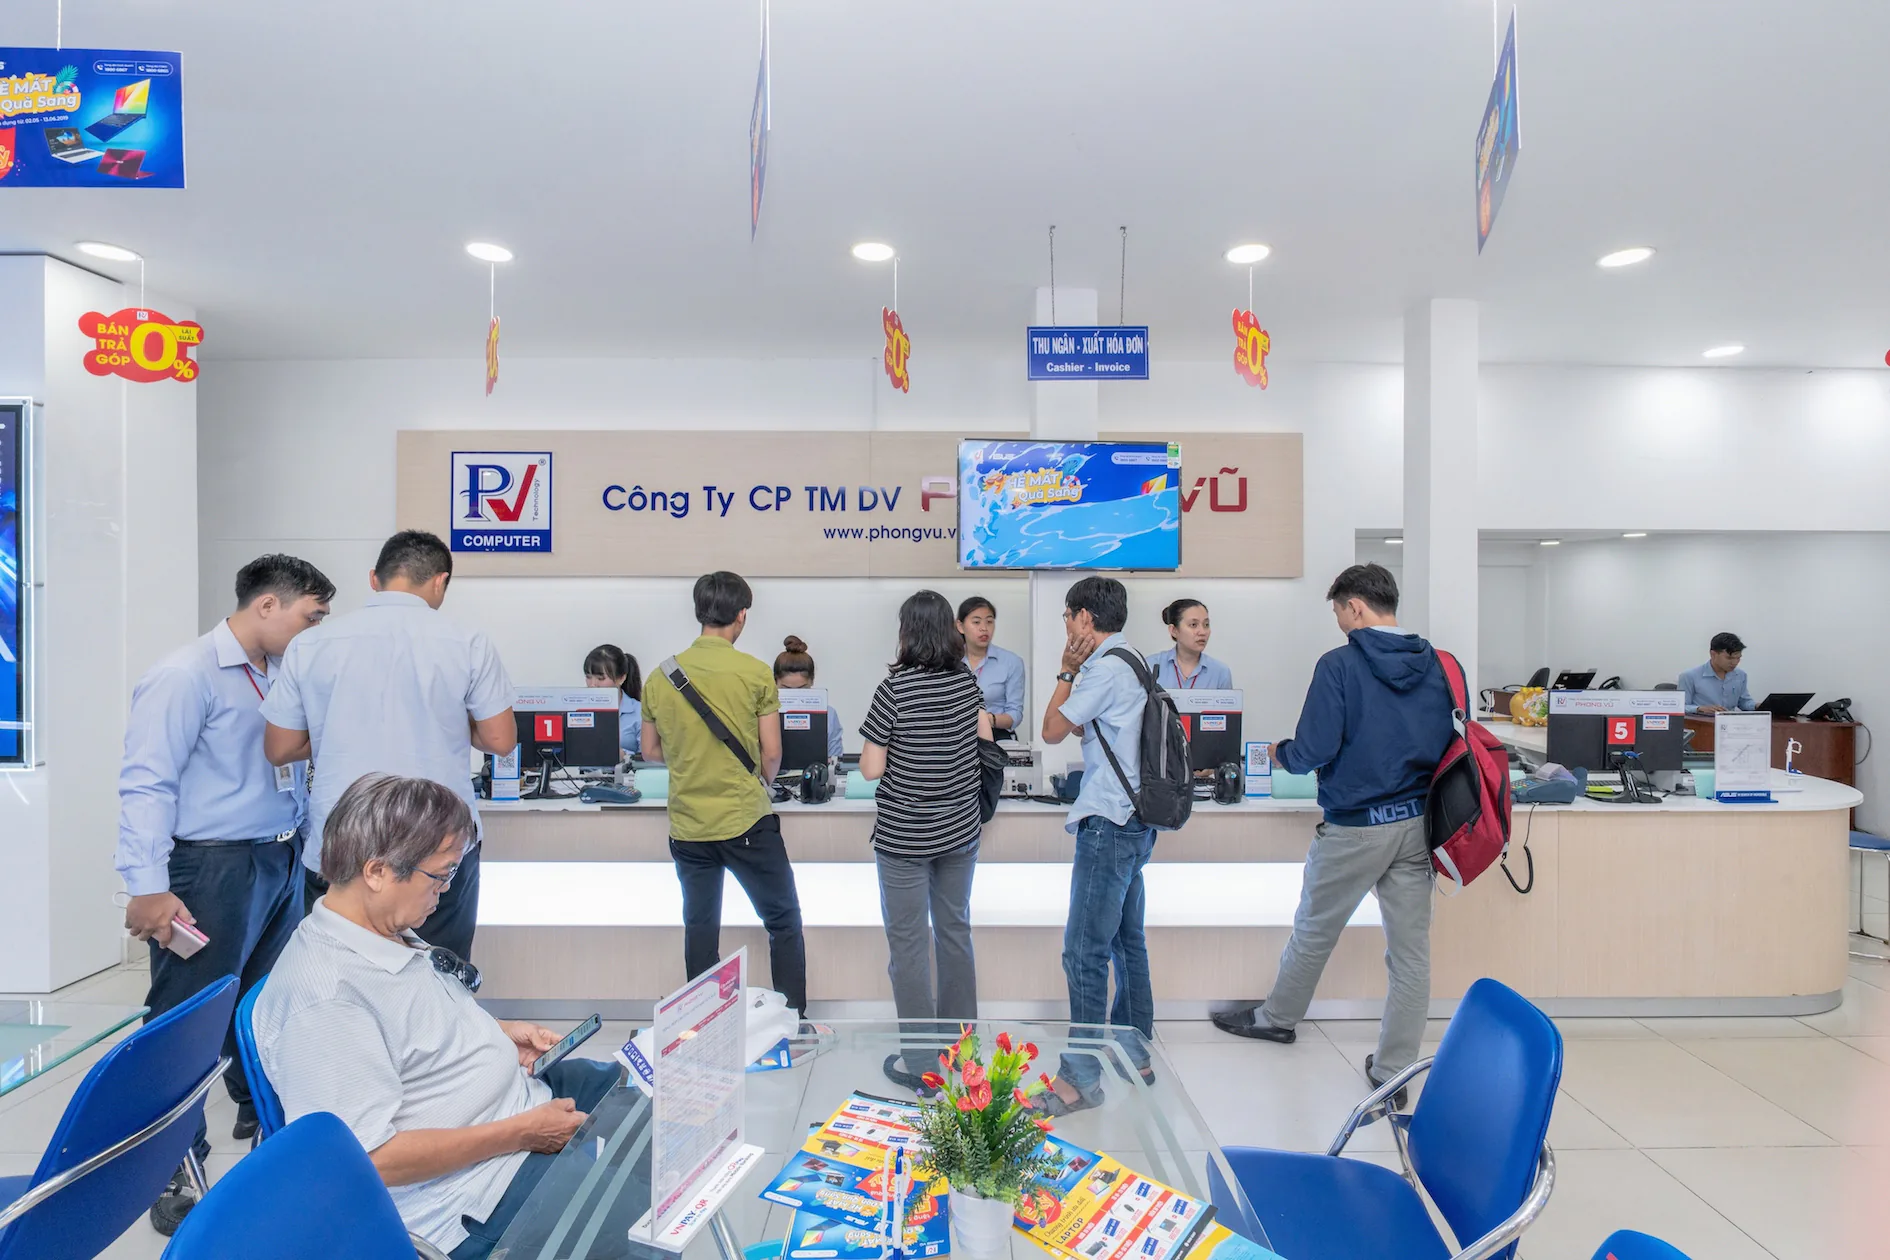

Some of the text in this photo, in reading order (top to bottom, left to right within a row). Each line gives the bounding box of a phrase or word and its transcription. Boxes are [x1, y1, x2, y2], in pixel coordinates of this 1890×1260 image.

[14, 77, 52, 94] MÁT
[1, 96, 77, 112] Quà Sang
[97, 322, 129, 336] BÁN
[99, 338, 127, 351] TRẢ
[1033, 336, 1049, 354] THU
[1052, 333, 1075, 354] NGÂN
[1082, 331, 1104, 354] XUẤT
[1107, 332, 1124, 354] HÓA
[1126, 335, 1144, 354] ĐƠN
[96, 353, 131, 366] GÓP
[1046, 362, 1084, 372] Cashier
[1095, 362, 1131, 372] Invoice
[1029, 472, 1059, 487] MÁT
[602, 484, 690, 518] Công
[703, 486, 735, 517] Ty
[749, 485, 792, 512] CP
[805, 486, 847, 512] TM
[858, 486, 902, 512] DV
[1019, 490, 1043, 502] Quà
[463, 535, 541, 547] COMPUTER
[823, 525, 957, 542] www.phongvu.v
[543, 720, 553, 737] 1
[1614, 722, 1628, 740] 5
[1368, 799, 1418, 825] NOST
[1055, 1217, 1084, 1245] LAPTOP
